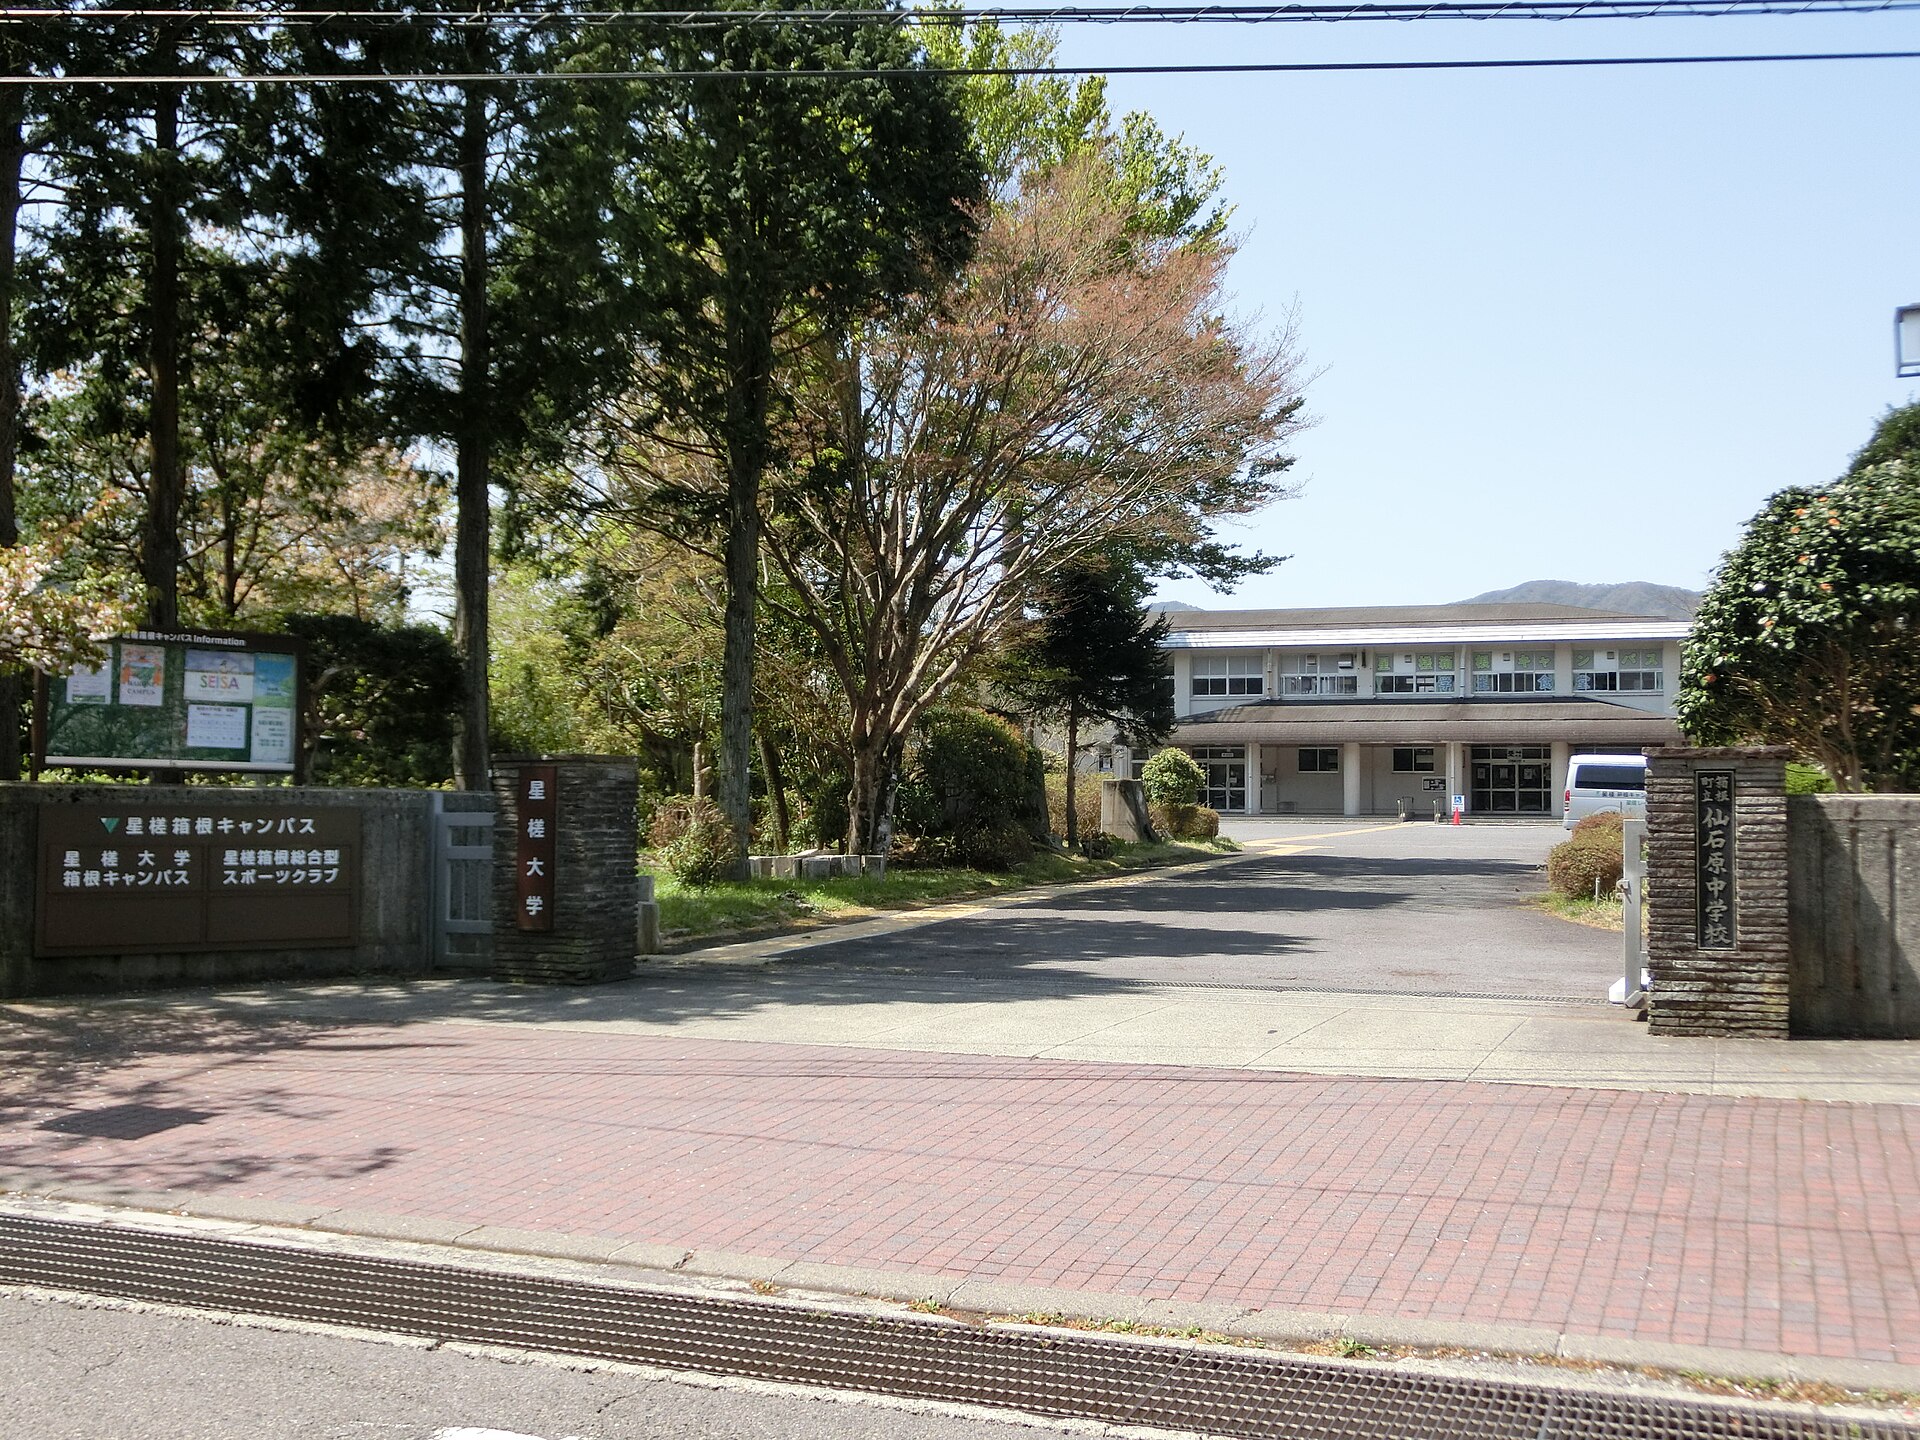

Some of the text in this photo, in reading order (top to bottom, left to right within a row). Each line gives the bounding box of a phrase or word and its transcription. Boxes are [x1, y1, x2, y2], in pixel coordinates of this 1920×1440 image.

[193, 634, 247, 646] Information
[199, 674, 240, 690] SEISA
[1700, 776, 1714, 802] 町立
[125, 816, 316, 836] 星槎箱根キャンパス
[526, 780, 546, 916] 星槎大学
[63, 850, 191, 868] 星槎大学
[222, 849, 340, 866] 星槎箱根総合型
[63, 869, 191, 888] 箱根キャンパス
[222, 868, 340, 885] スポーツクラブ
[1701, 807, 1731, 945] 仙石原中学校
